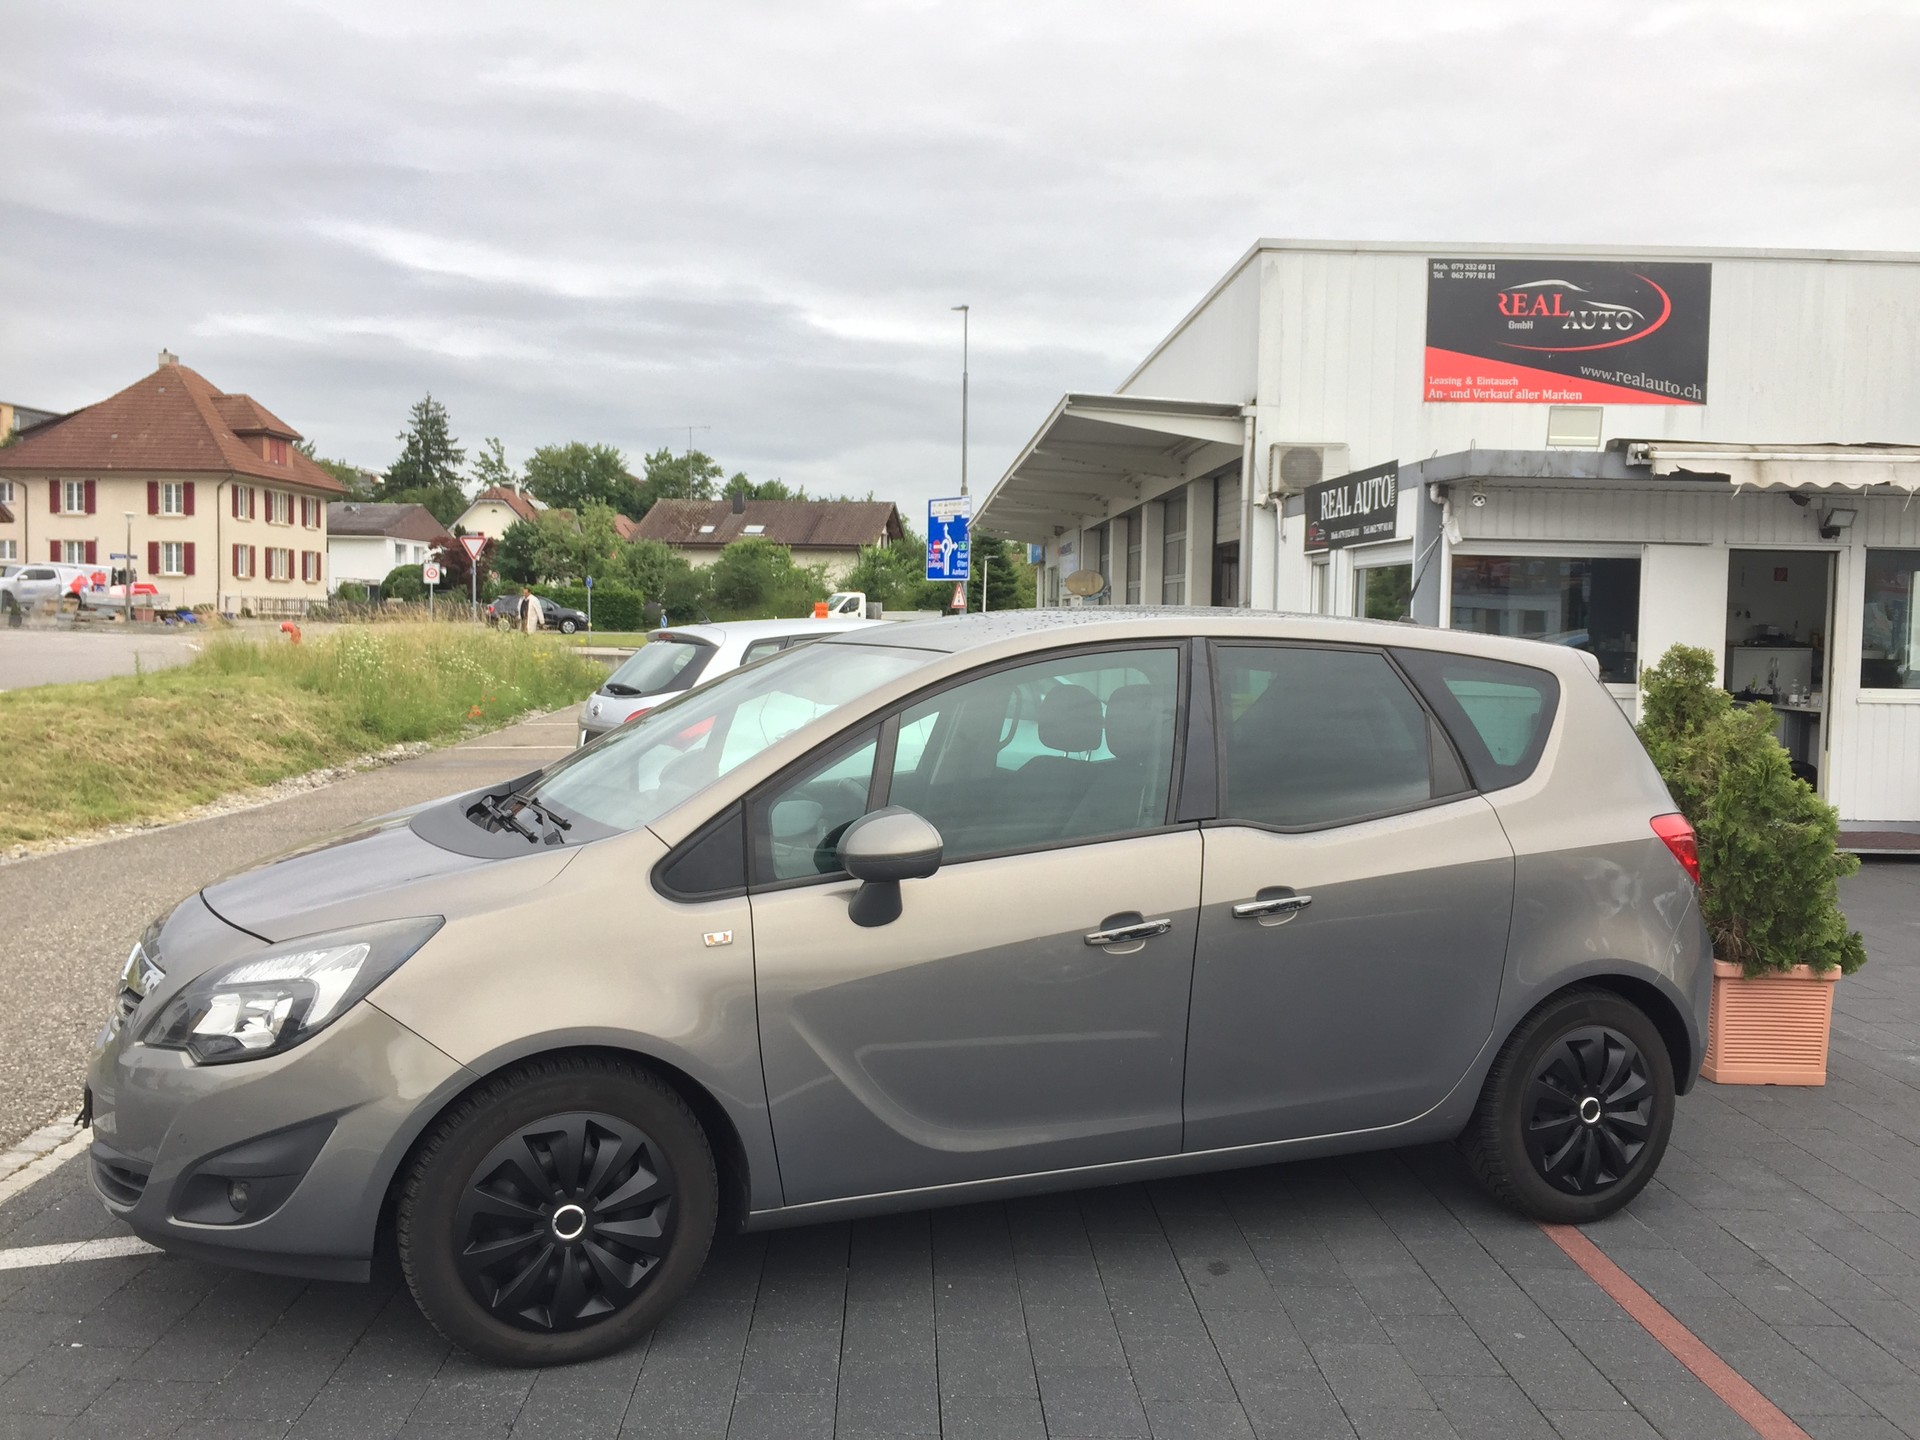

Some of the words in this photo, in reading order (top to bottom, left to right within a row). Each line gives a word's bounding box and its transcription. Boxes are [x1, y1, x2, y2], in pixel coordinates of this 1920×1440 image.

[1433, 271, 1445, 279] Tel.
[1497, 292, 1570, 317] REAL
[1508, 320, 1534, 330] GmbH
[1562, 310, 1634, 331] AUTO
[1429, 376, 1462, 387] Leasing
[1465, 377, 1473, 386] &
[1477, 376, 1519, 386] Eintausch
[1580, 366, 1702, 400] www.realauto.ch
[1428, 388, 1447, 399] An-
[1450, 389, 1470, 399] und
[1473, 389, 1513, 399] Verkauf
[1516, 389, 1540, 400] aller
[1542, 389, 1583, 400] Marken
[1320, 486, 1352, 521] REAL
[1353, 475, 1391, 515] AUTO
